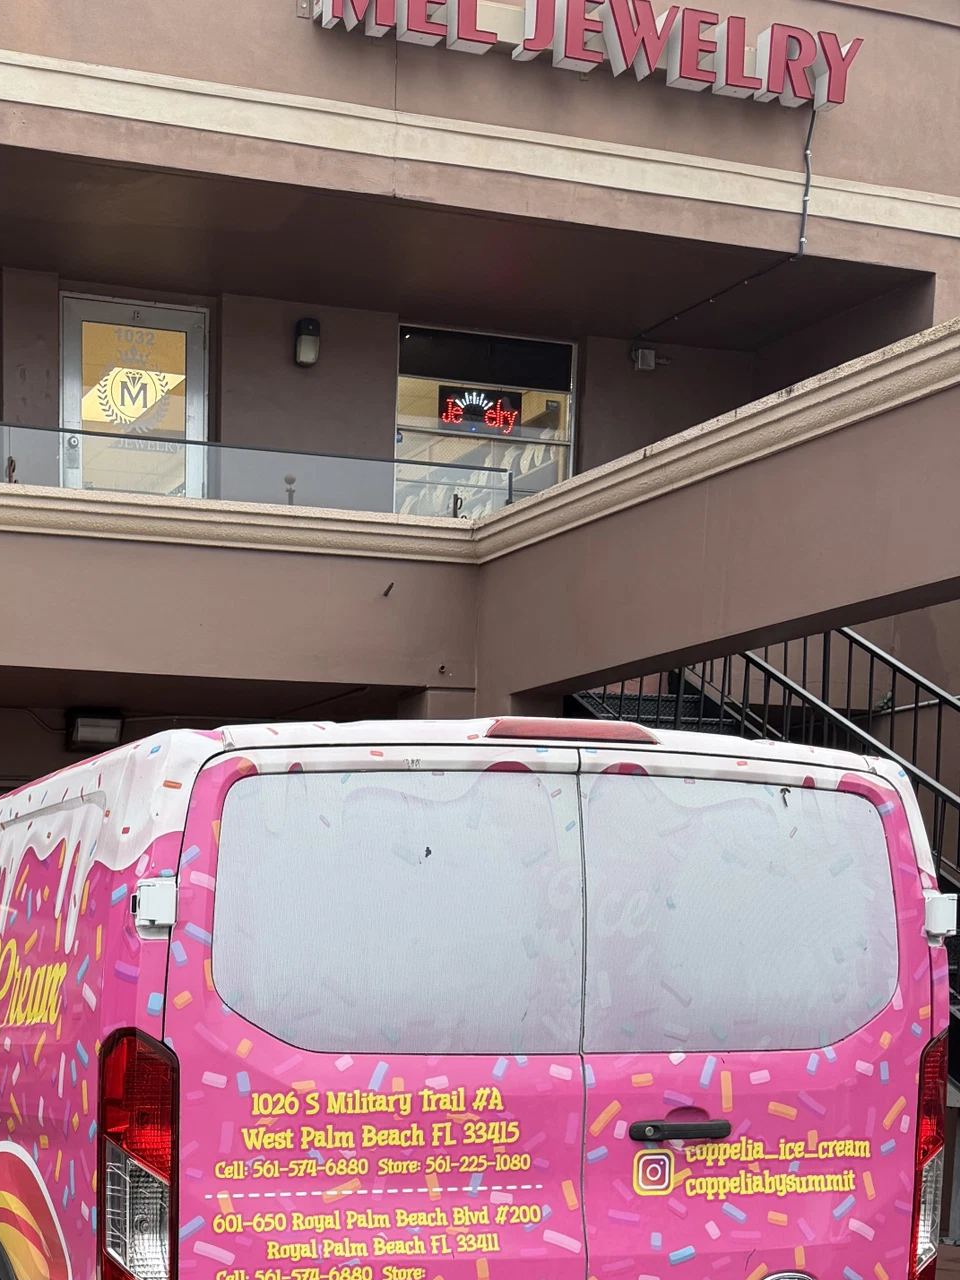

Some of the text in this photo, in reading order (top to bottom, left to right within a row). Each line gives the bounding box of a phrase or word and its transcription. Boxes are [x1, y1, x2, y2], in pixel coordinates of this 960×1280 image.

[514, 0, 865, 110] JEWELRY
[113, 328, 156, 347] 1032
[120, 380, 148, 409] M
[251, 1086, 504, 1116] 1026 S Military Trail #A
[241, 1120, 520, 1150] West Palm Beach FL 33415
[685, 1135, 871, 1167] coppelia_ice_cream
[214, 1153, 531, 1180] Cell: 561-574-6880 Store: 561-225-1080
[685, 1169, 856, 1200] coppeliabysummit
[213, 1204, 542, 1234] 601-650 Royal Palm Beach Blvd #200
[267, 1232, 500, 1262] Royal Palm Beach FL 33411
